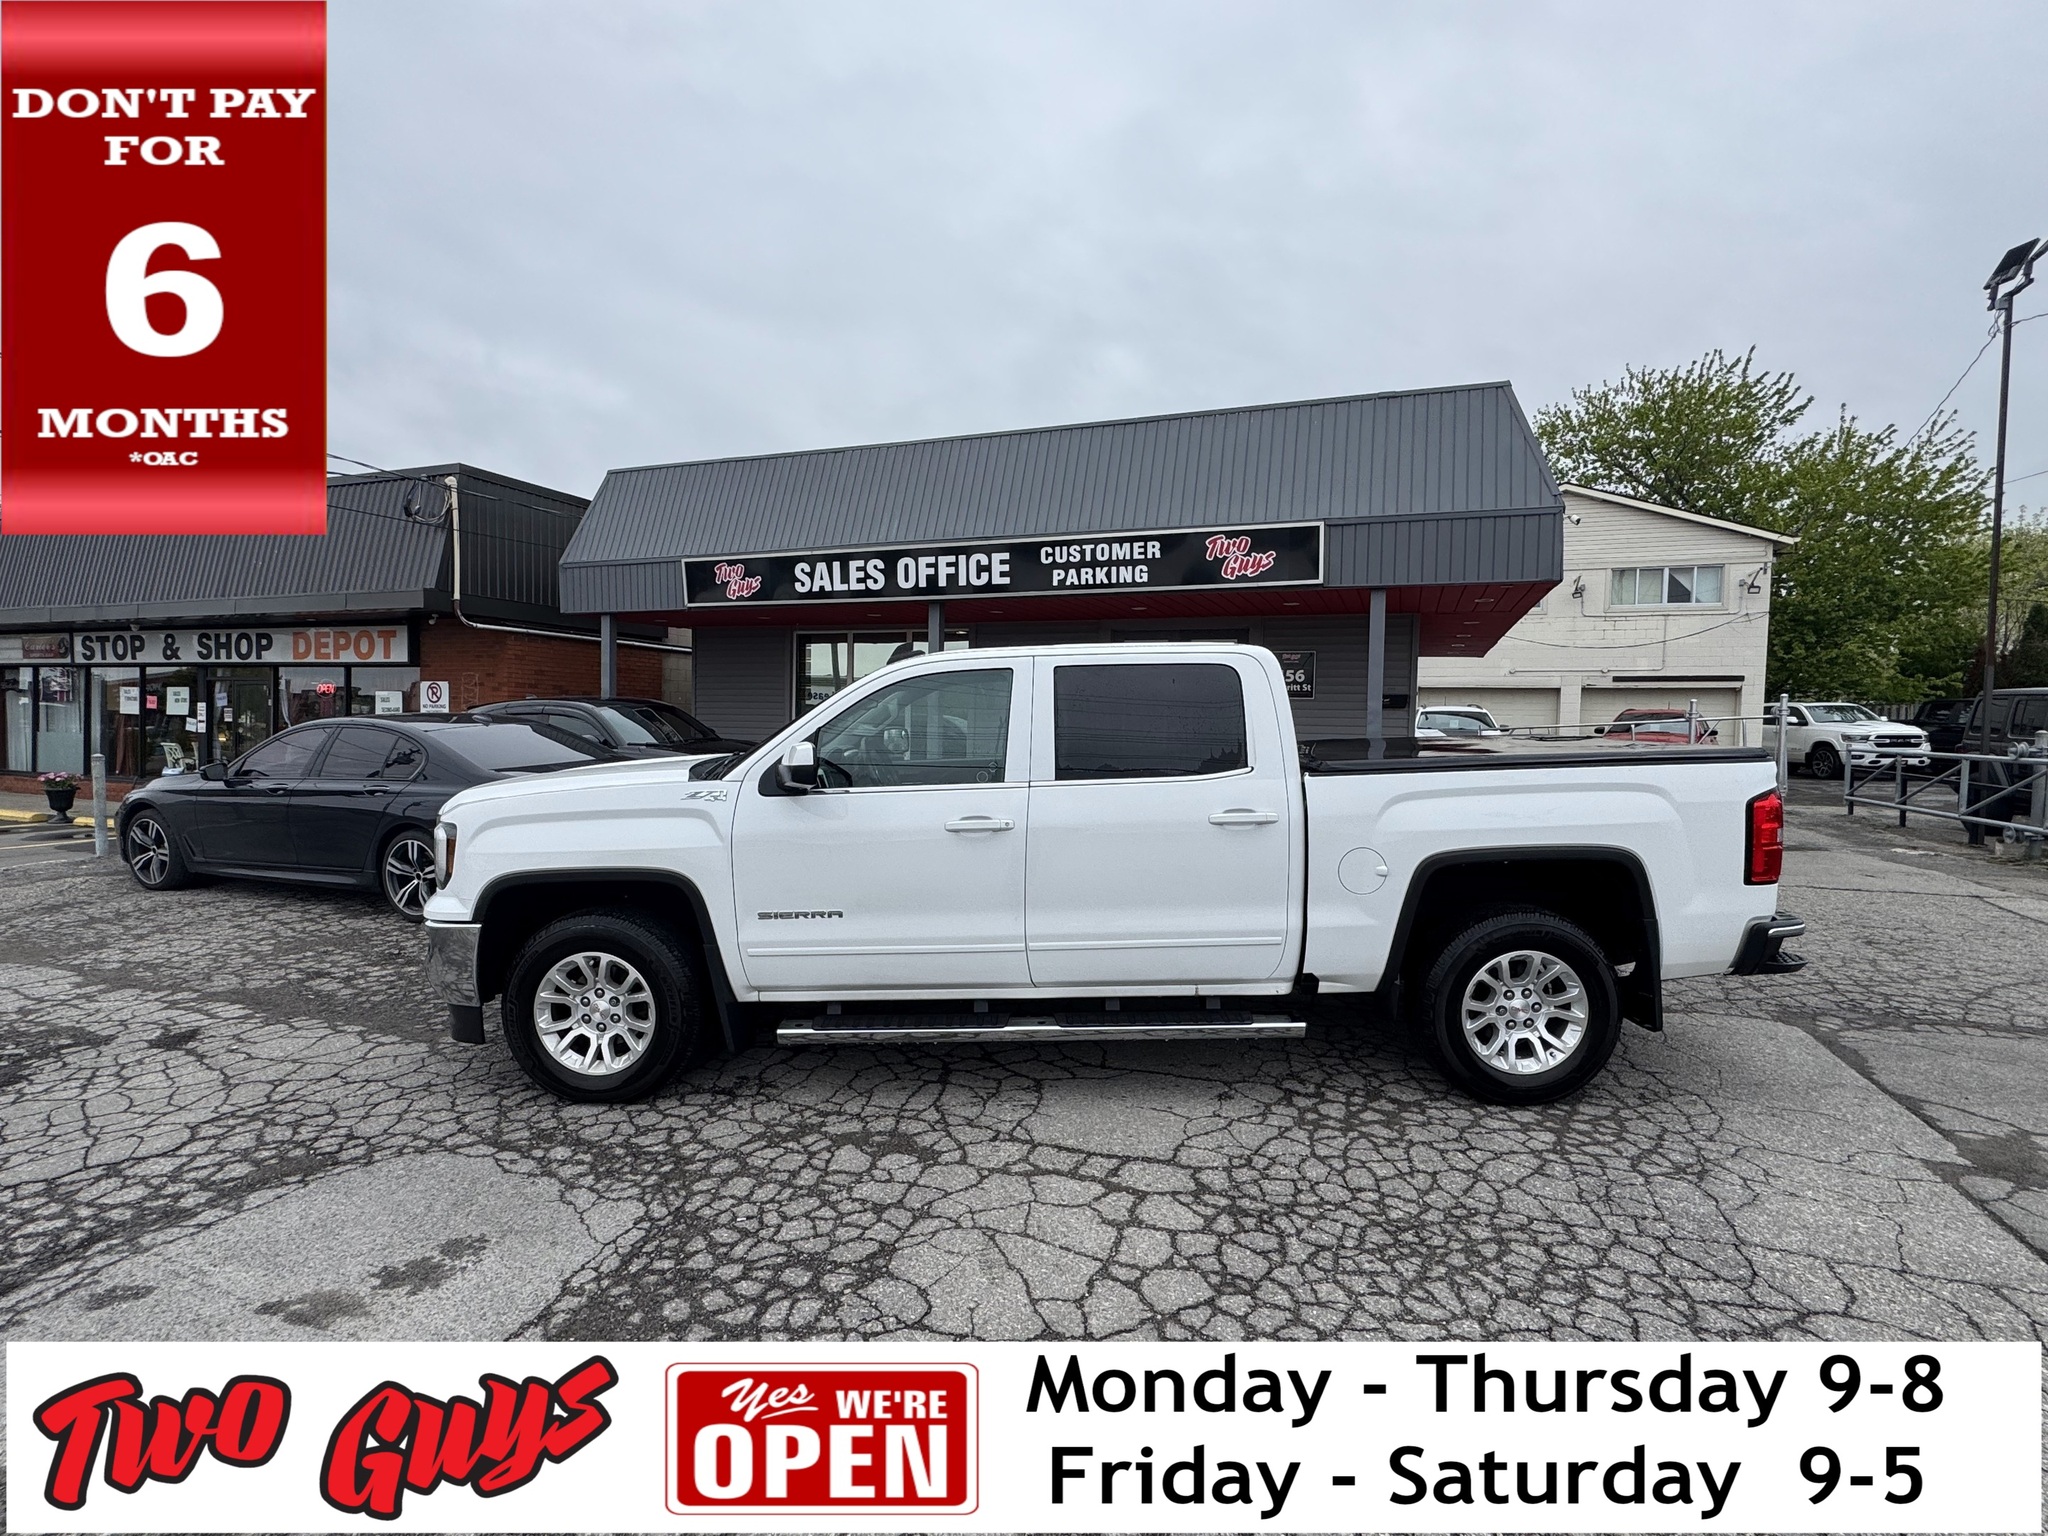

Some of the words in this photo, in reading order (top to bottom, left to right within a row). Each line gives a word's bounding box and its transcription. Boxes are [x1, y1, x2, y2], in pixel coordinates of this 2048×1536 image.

[1040, 541, 1161, 564] CUSTOMER
[1206, 534, 1251, 561] Two
[714, 562, 745, 585] Two
[794, 558, 886, 593] SALES
[896, 552, 1011, 590] OFFICE
[1052, 564, 1149, 587] PARKING
[1221, 550, 1276, 580] Guys
[726, 575, 762, 600] Guys
[81, 634, 146, 661] STOP
[162, 633, 182, 661] &
[197, 631, 274, 661] SHOP
[292, 629, 397, 661] DEPOT
[1284, 669, 1306, 683] 56
[316, 683, 336, 694] OPEN
[757, 910, 844, 921] SIERRA
